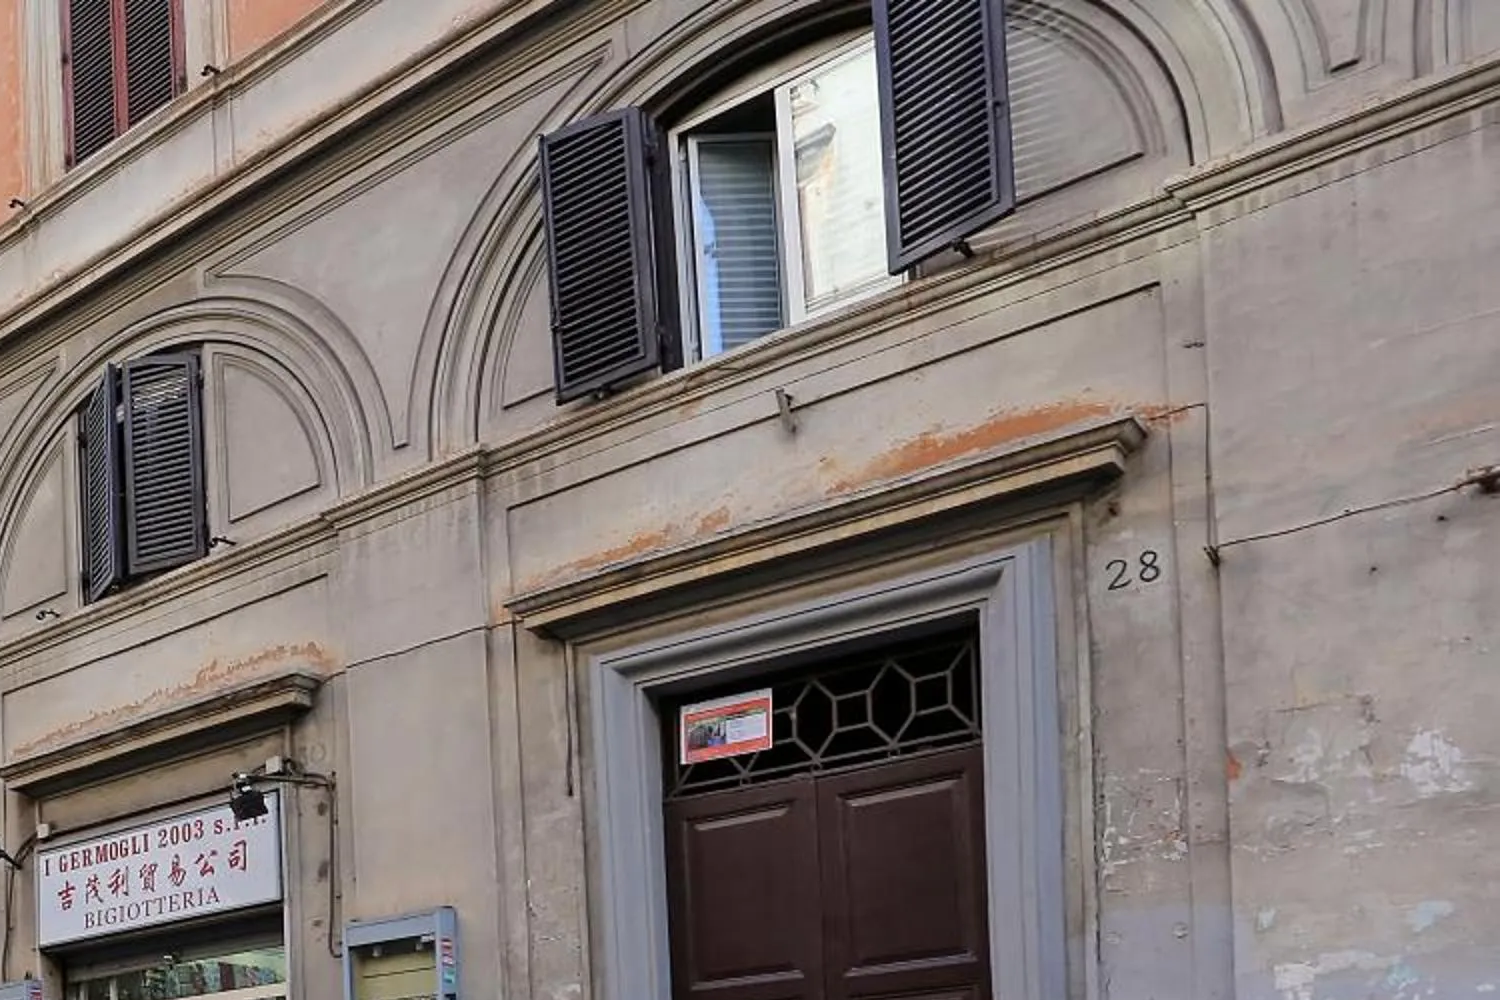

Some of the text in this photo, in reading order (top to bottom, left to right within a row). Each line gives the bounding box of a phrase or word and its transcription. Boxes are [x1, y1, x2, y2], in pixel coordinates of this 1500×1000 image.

[1104, 549, 1161, 591] 28
[44, 858, 51, 877] I
[59, 833, 149, 873] GERMOGLI
[157, 819, 204, 848] 2003
[84, 886, 220, 929] BIGIOTTERIA
